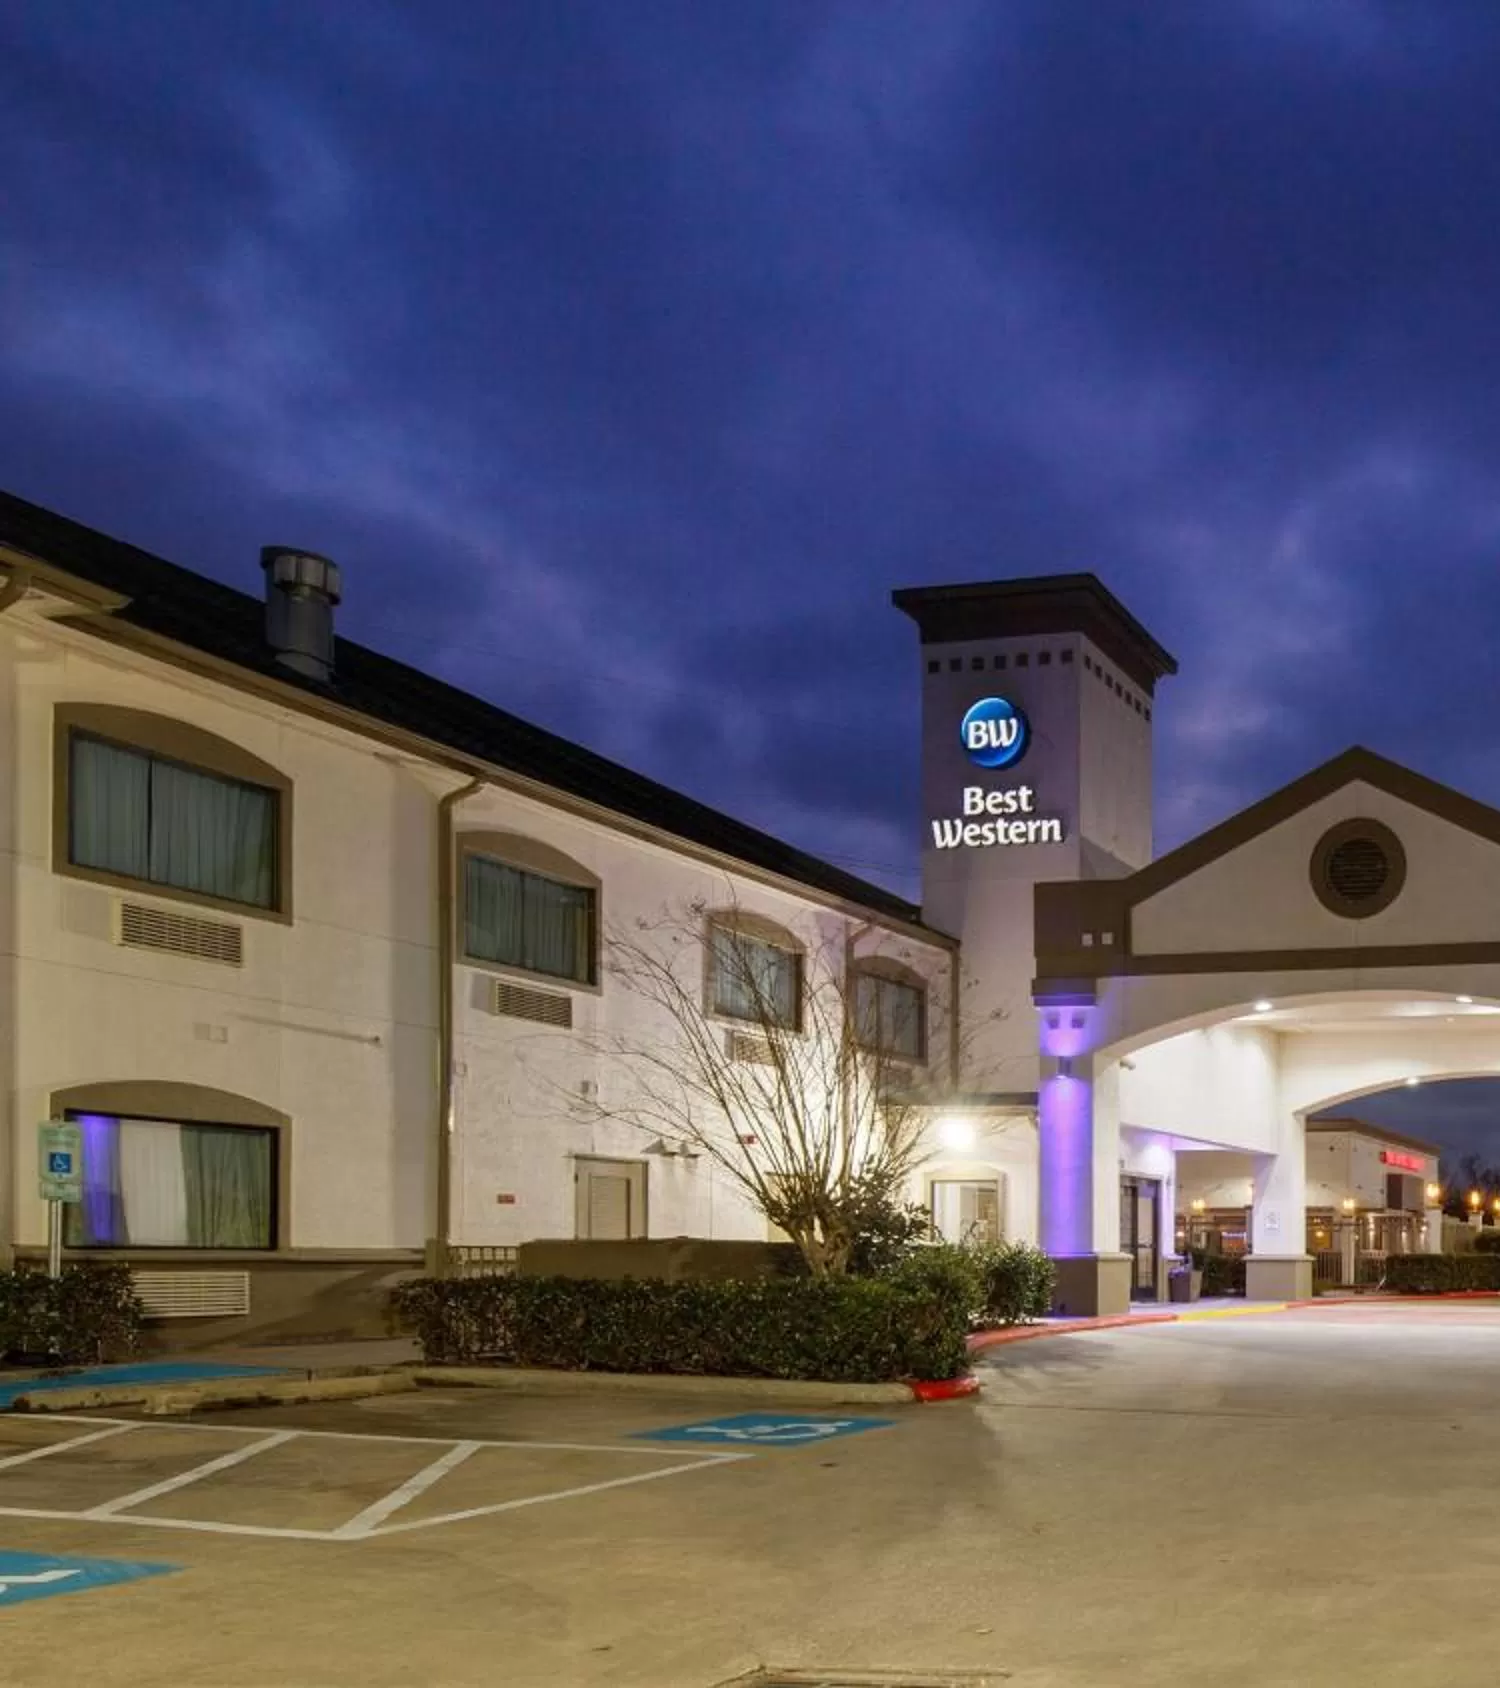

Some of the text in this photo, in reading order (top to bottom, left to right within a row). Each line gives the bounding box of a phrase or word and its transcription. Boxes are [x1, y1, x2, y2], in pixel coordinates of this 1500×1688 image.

[967, 717, 1019, 750] BW
[963, 785, 1034, 817] Best
[931, 818, 1064, 849] Western
